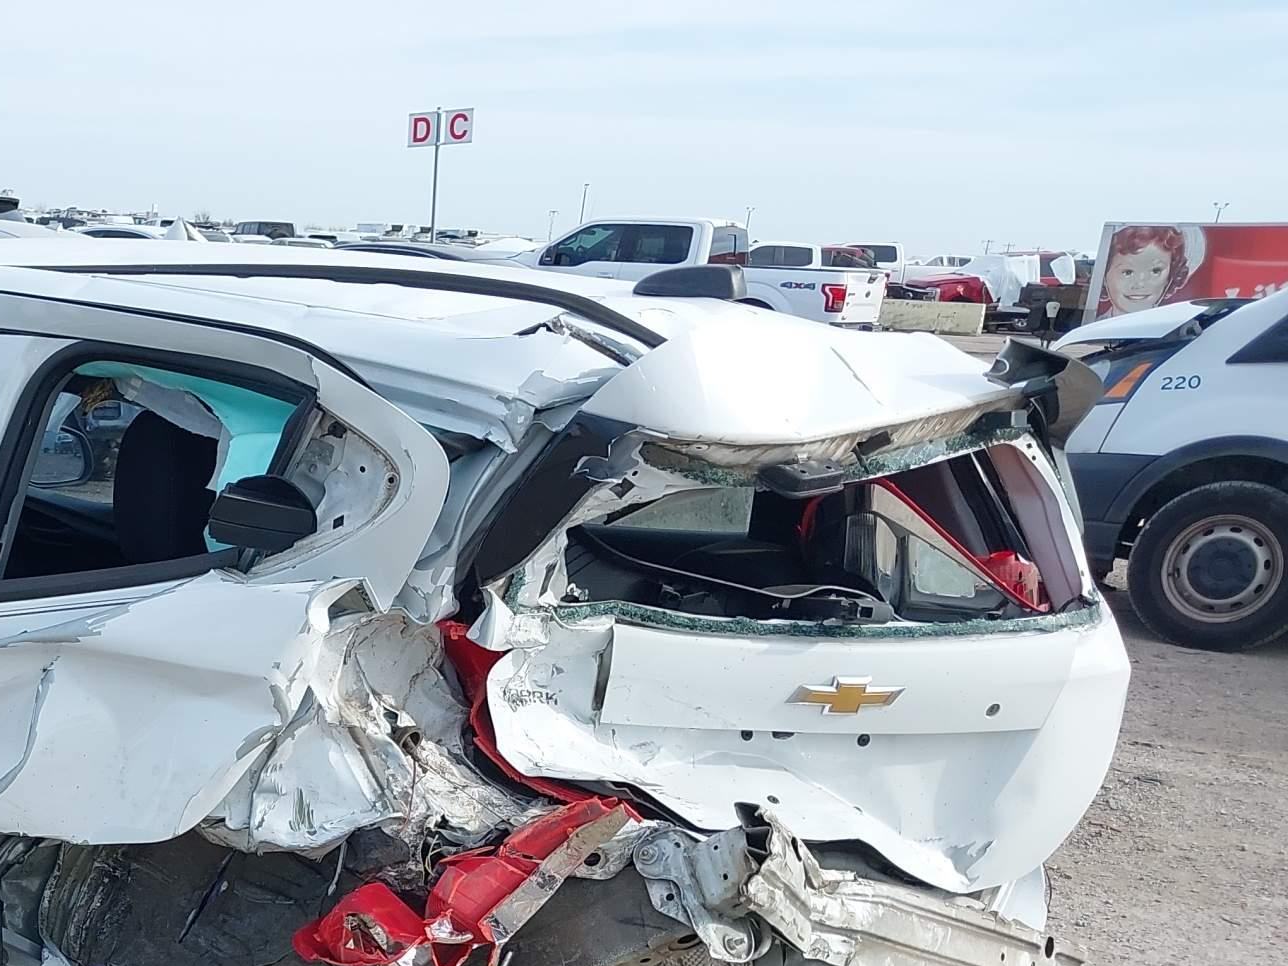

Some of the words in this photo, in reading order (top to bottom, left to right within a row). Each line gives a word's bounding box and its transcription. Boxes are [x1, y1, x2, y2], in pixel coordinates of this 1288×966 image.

[412, 117, 431, 143] D
[449, 113, 469, 140] C
[1161, 375, 1201, 391] 220
